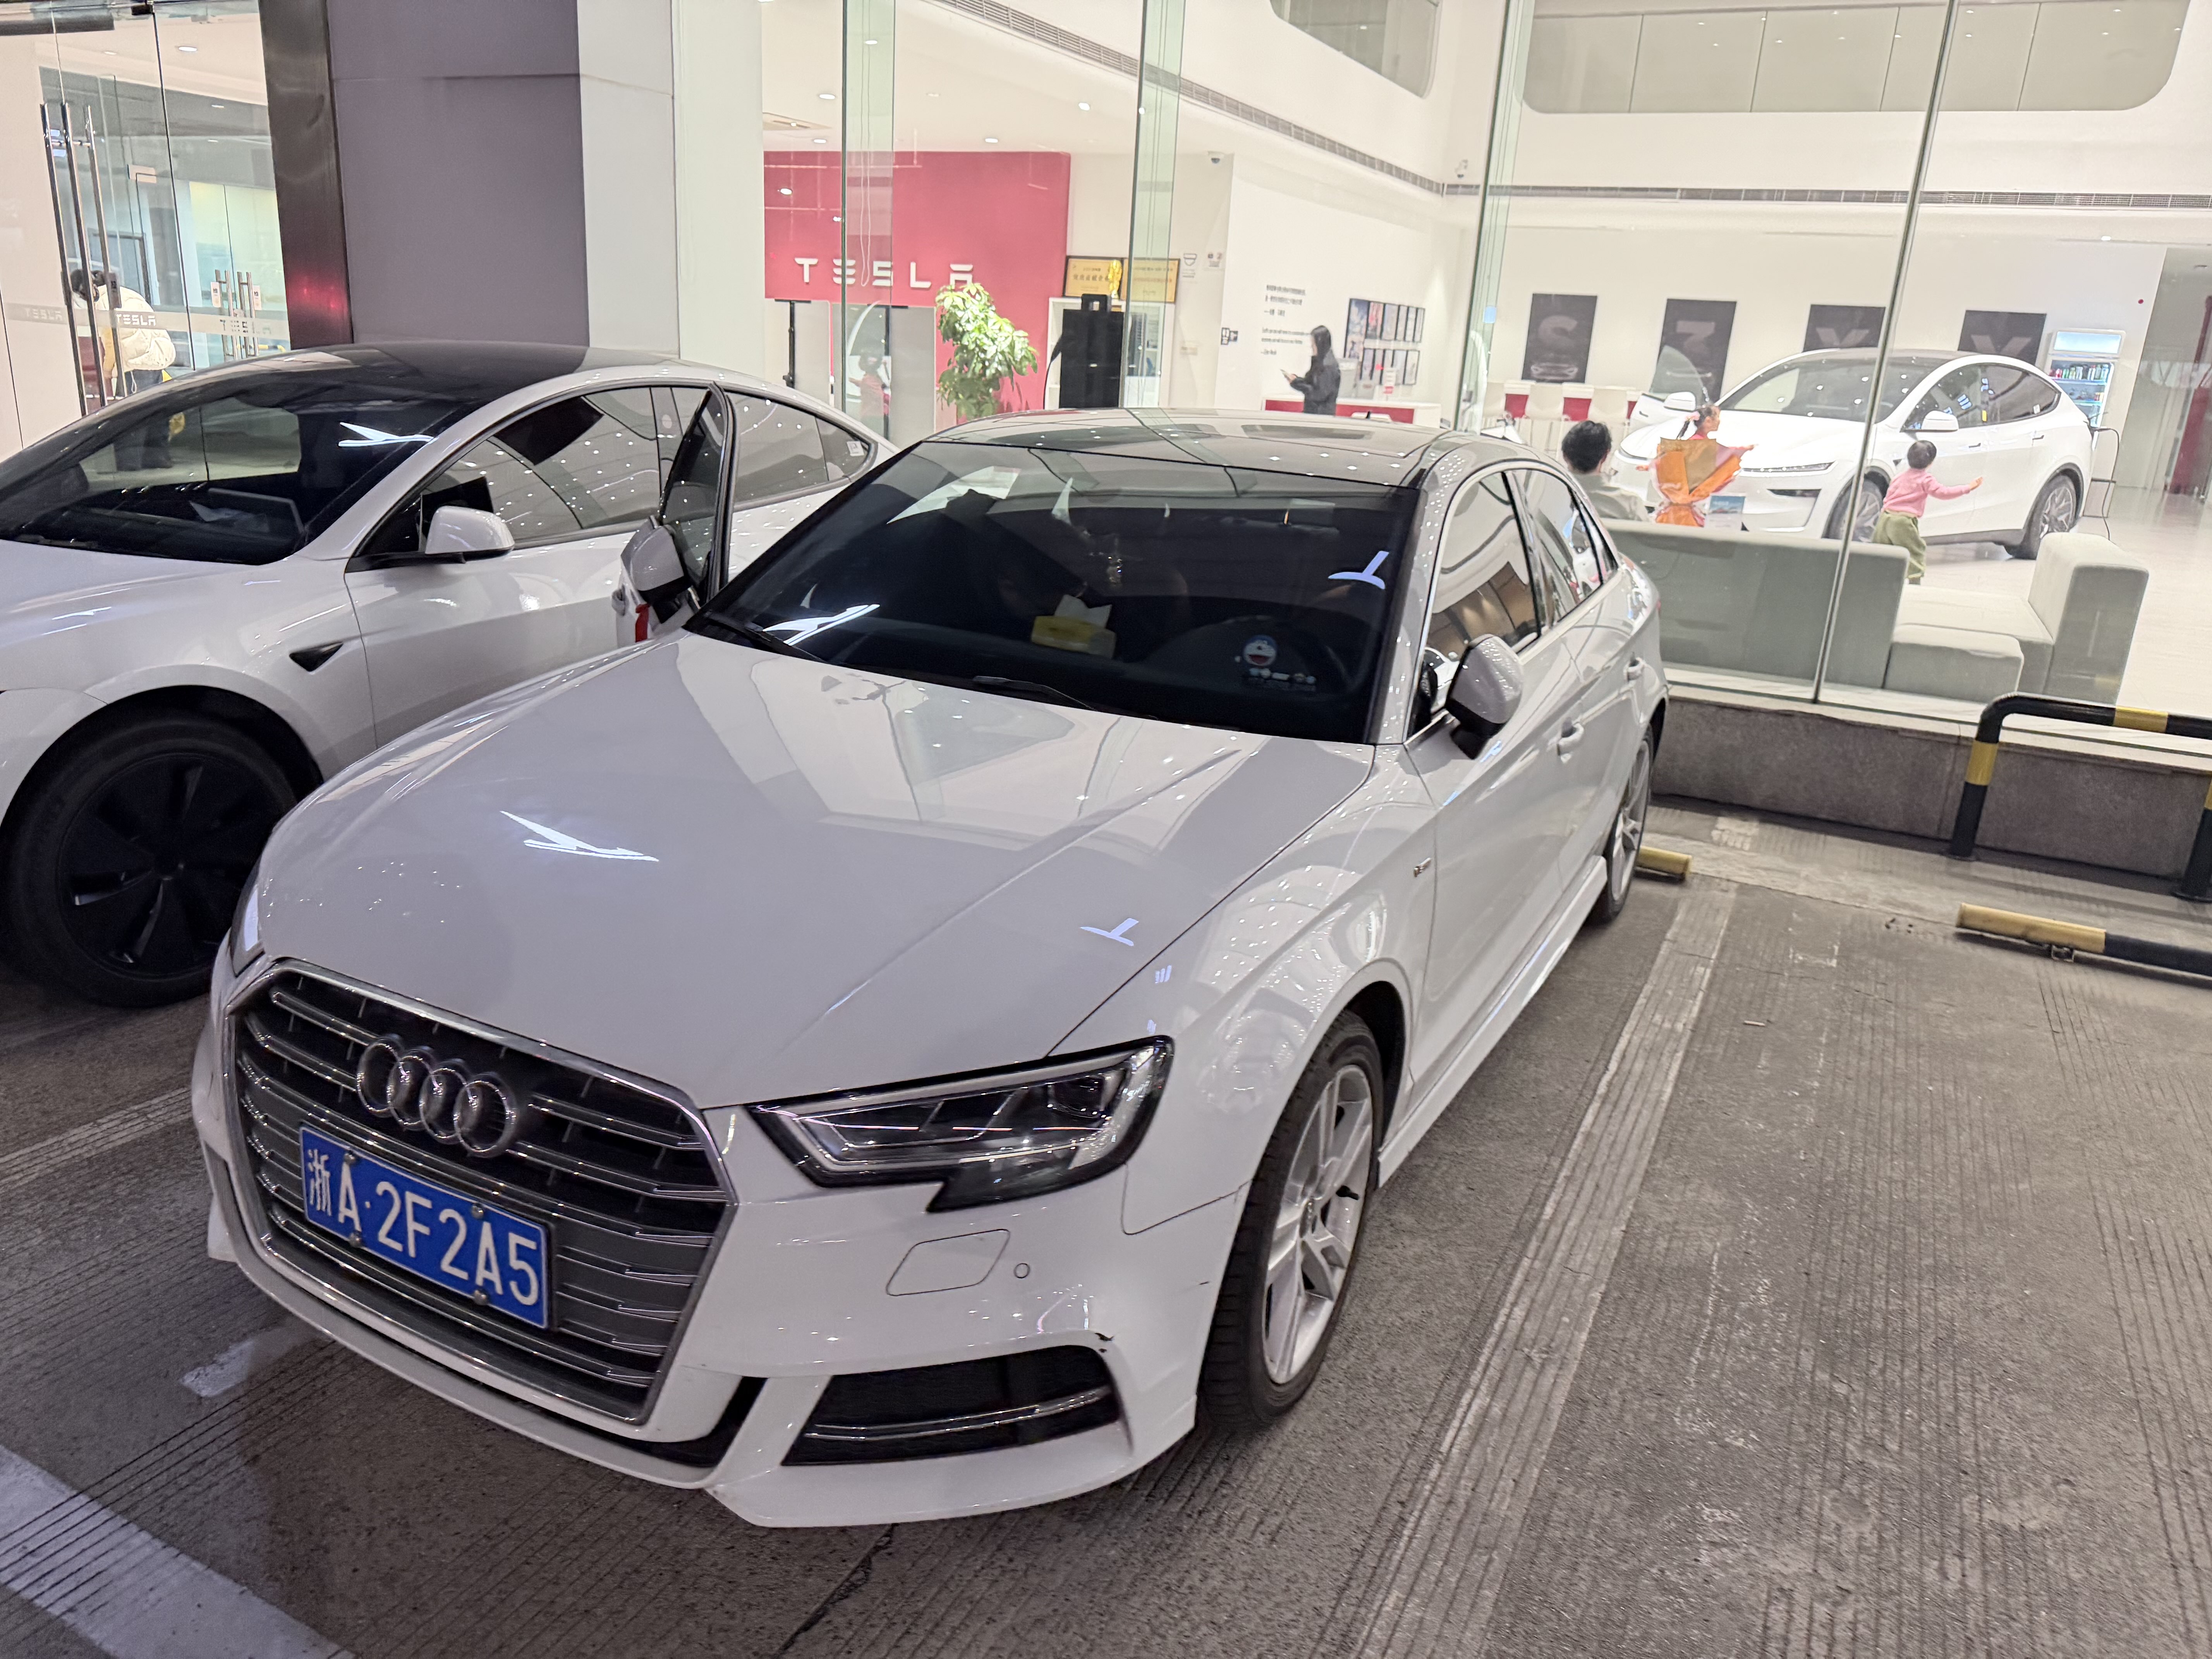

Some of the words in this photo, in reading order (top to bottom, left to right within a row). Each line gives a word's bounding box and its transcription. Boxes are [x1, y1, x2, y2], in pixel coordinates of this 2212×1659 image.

[794, 257, 973, 290] TESLA
[116, 314, 156, 326] TESLA
[308, 1149, 539, 1306] 浙A·2F2A5
